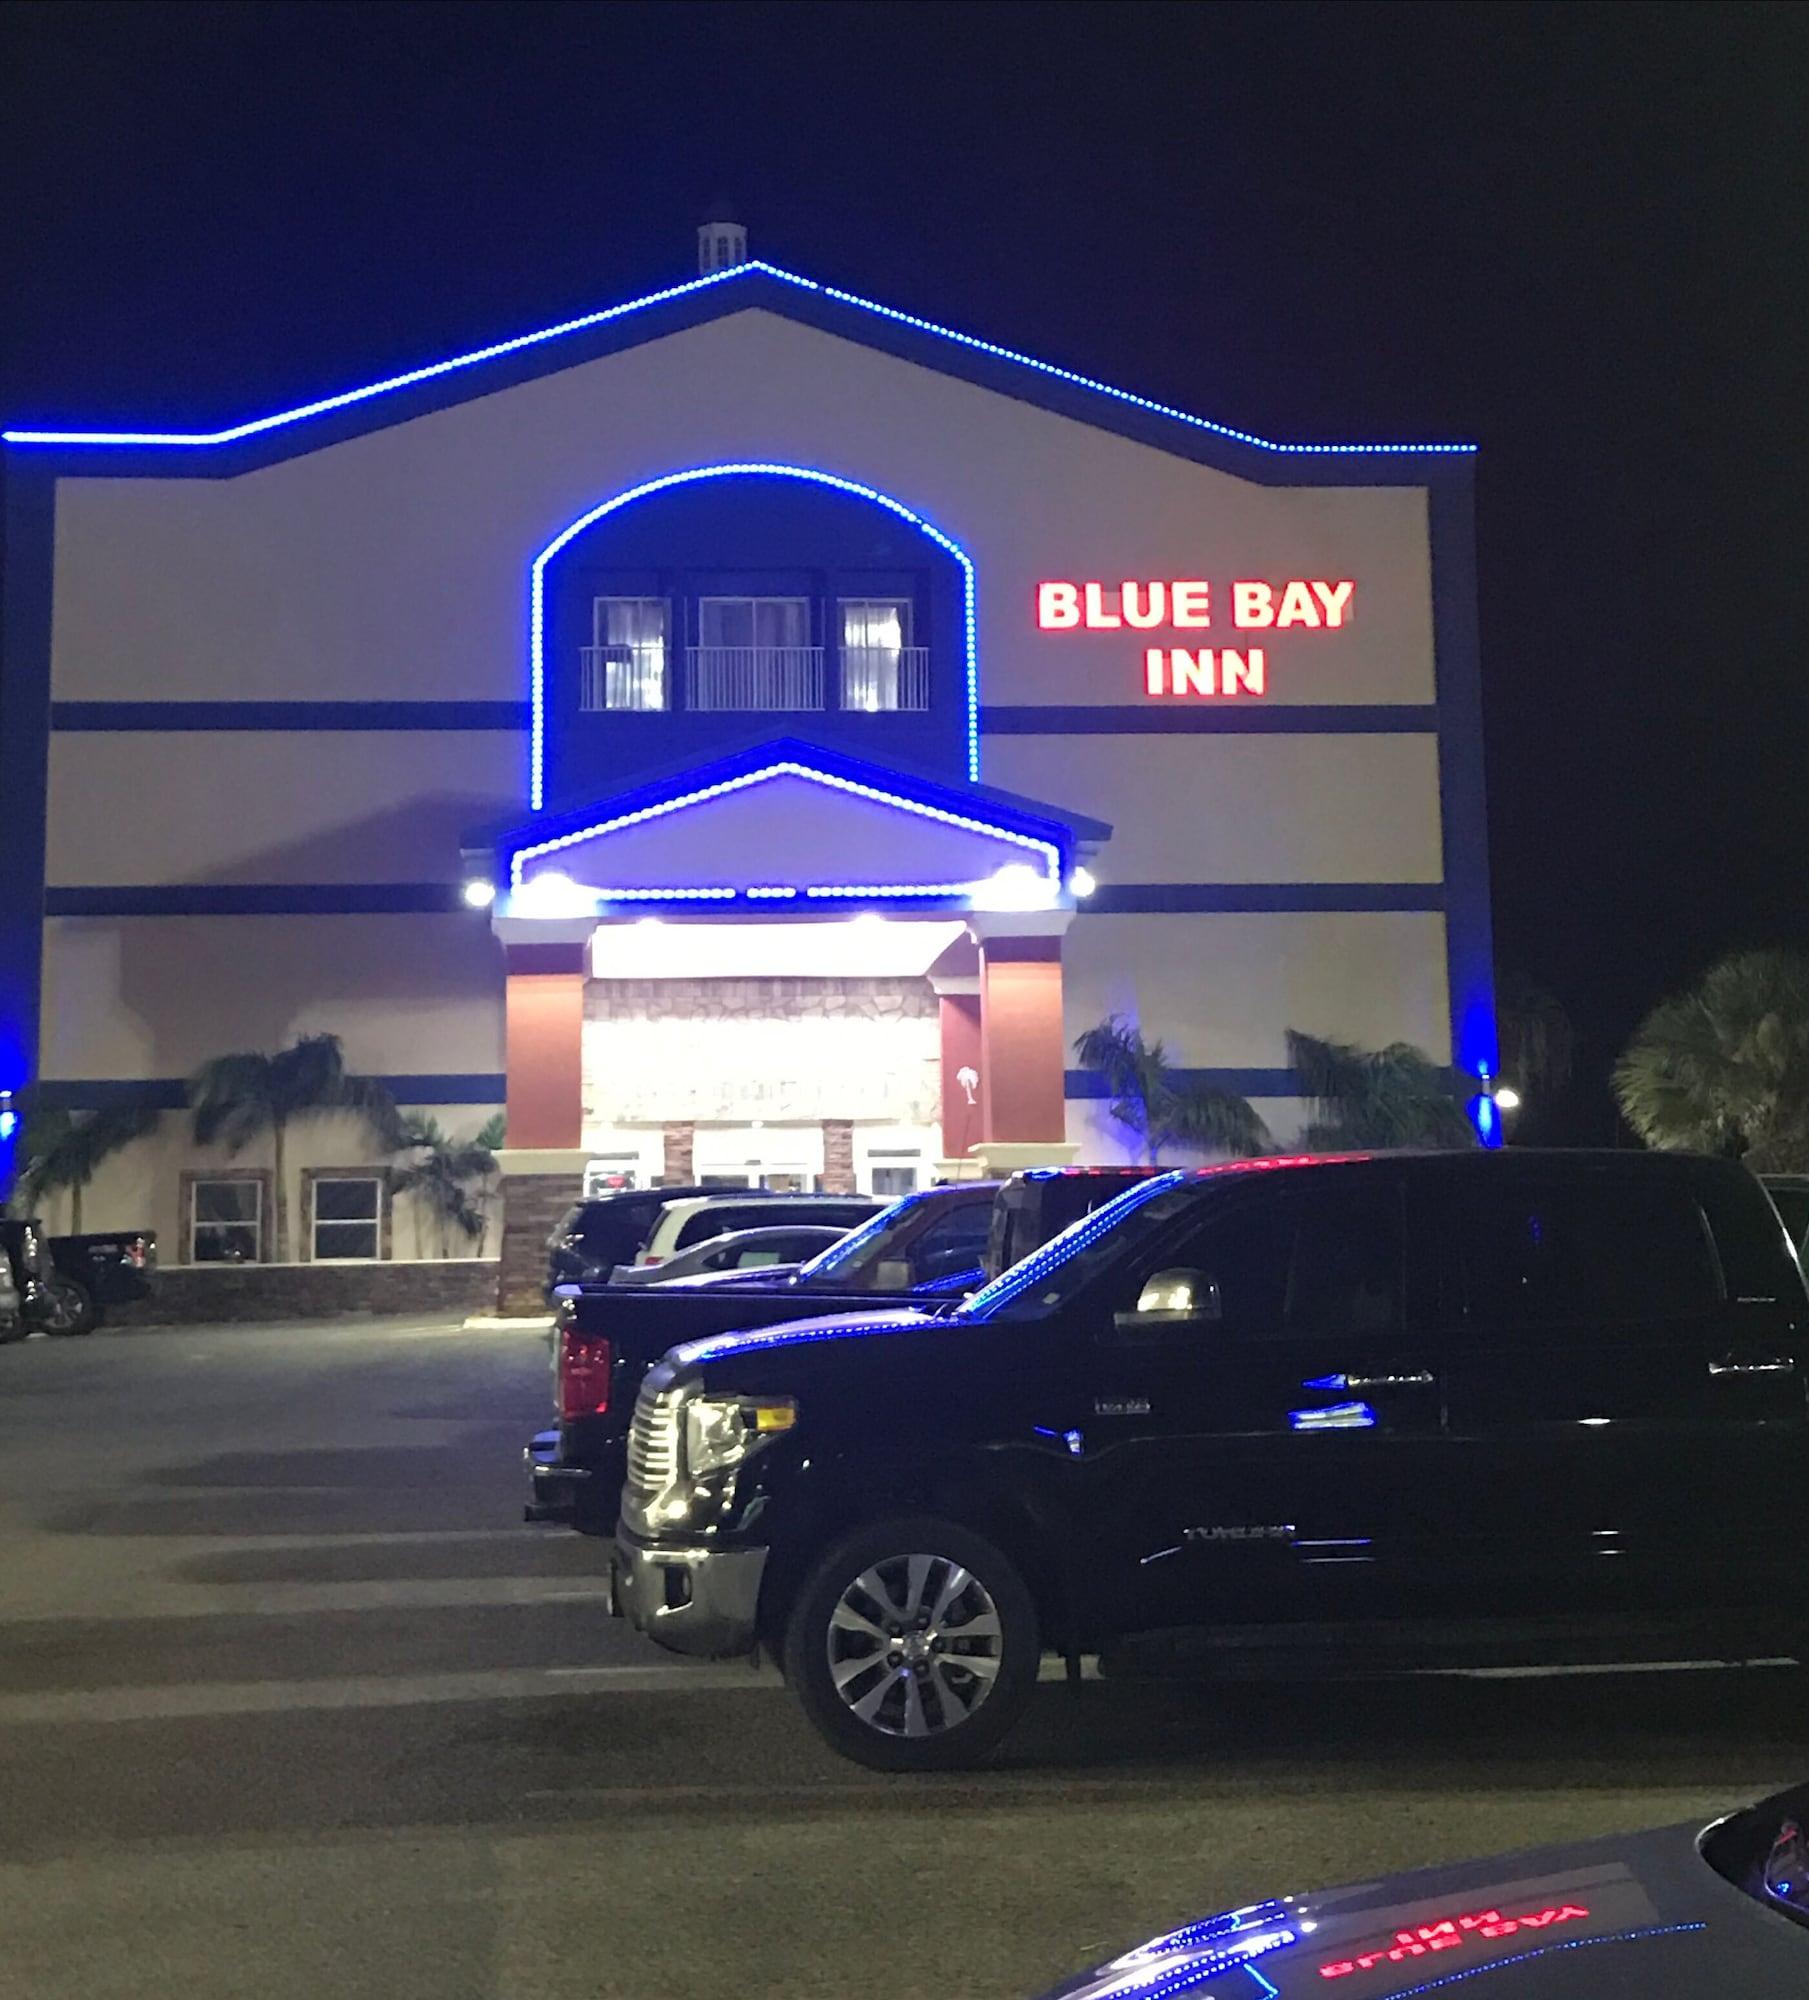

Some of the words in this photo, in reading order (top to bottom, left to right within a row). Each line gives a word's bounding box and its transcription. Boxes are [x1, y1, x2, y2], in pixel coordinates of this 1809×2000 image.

[1037, 581, 1211, 629] BLUE
[1232, 580, 1355, 629] BAY
[1145, 648, 1265, 696] INN
